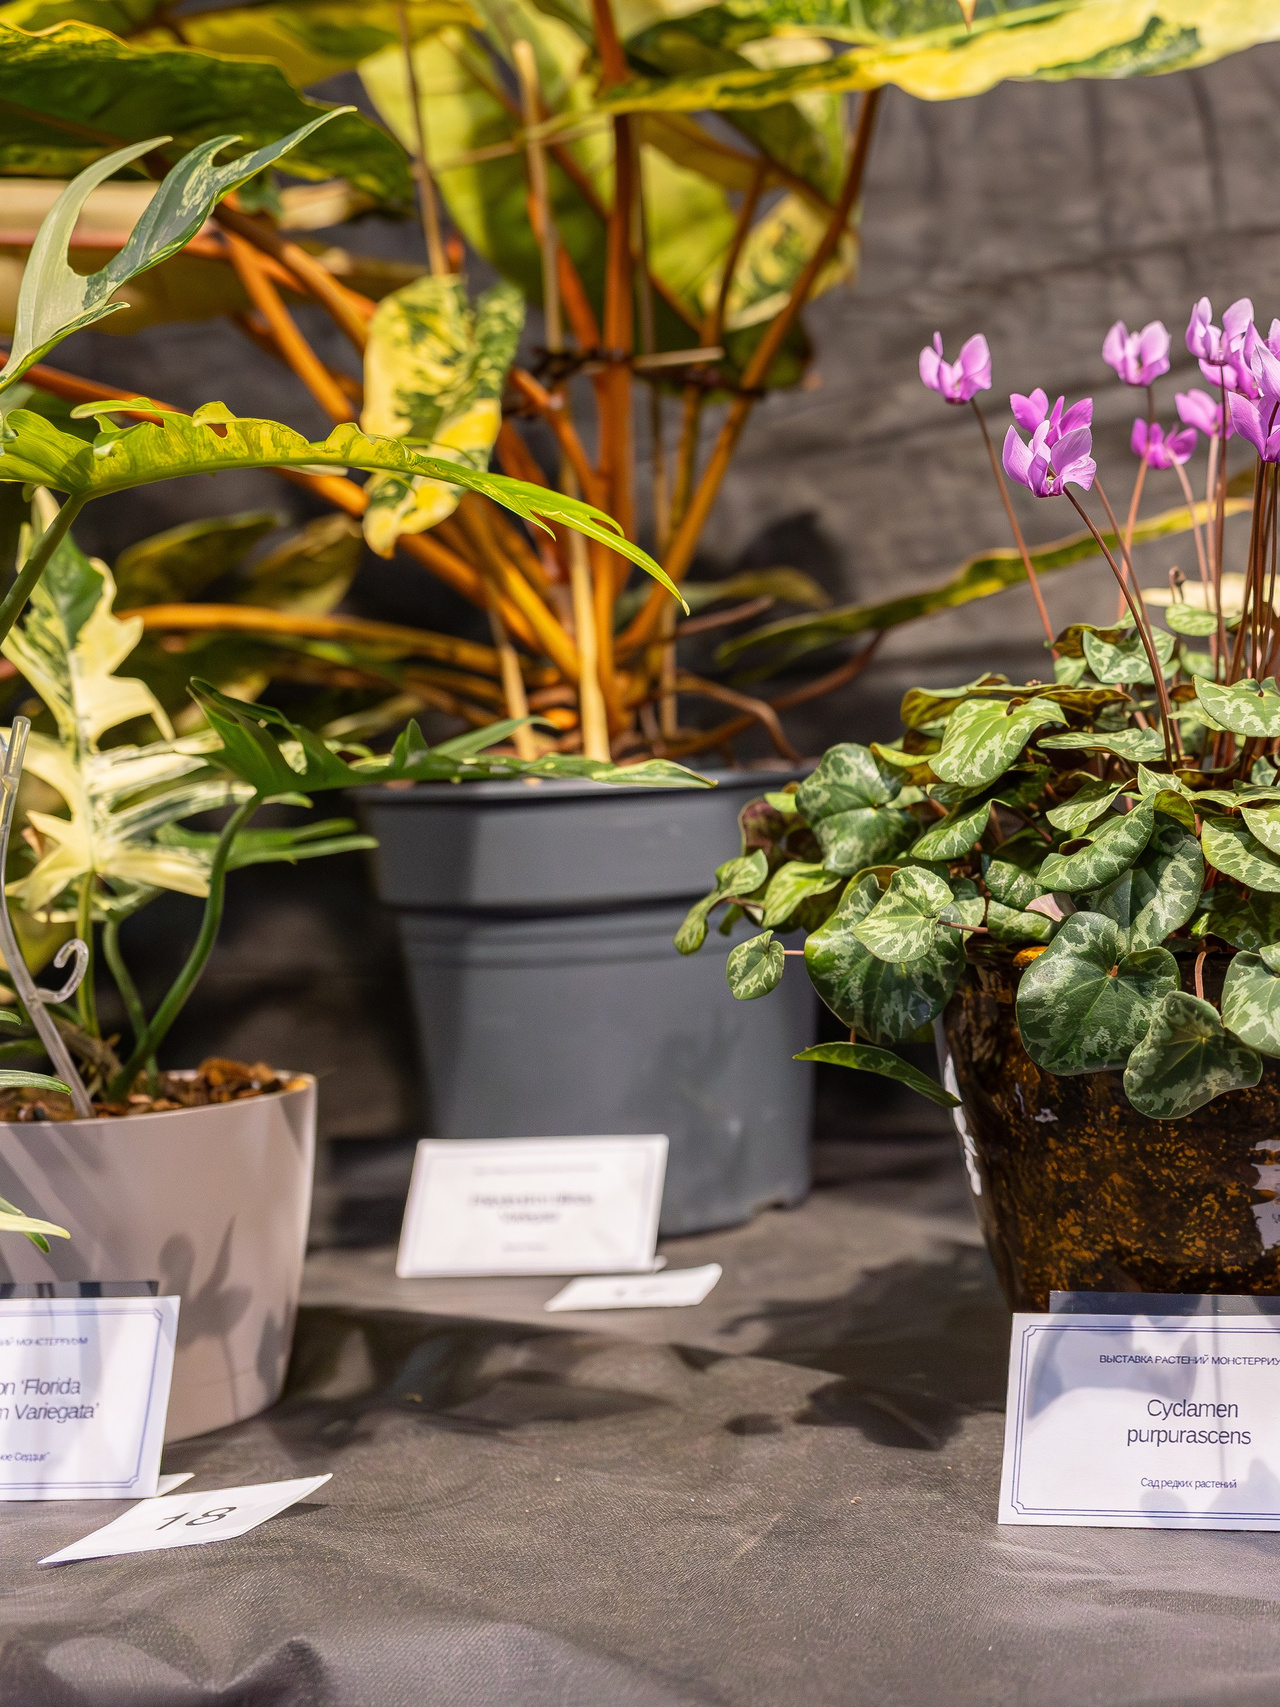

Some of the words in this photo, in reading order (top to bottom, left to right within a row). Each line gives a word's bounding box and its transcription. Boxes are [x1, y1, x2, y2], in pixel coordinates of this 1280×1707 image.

[1099, 1354, 1153, 1364] ВЫСТАВКА
[1155, 1354, 1209, 1365] РАСТЕНИЙ
[1147, 1398, 1238, 1421] Cyclamen
[1126, 1429, 1252, 1448] purpurascens
[1140, 1477, 1160, 1489] Сад
[1194, 1479, 1238, 1490] растений
[154, 1506, 237, 1531] 18
